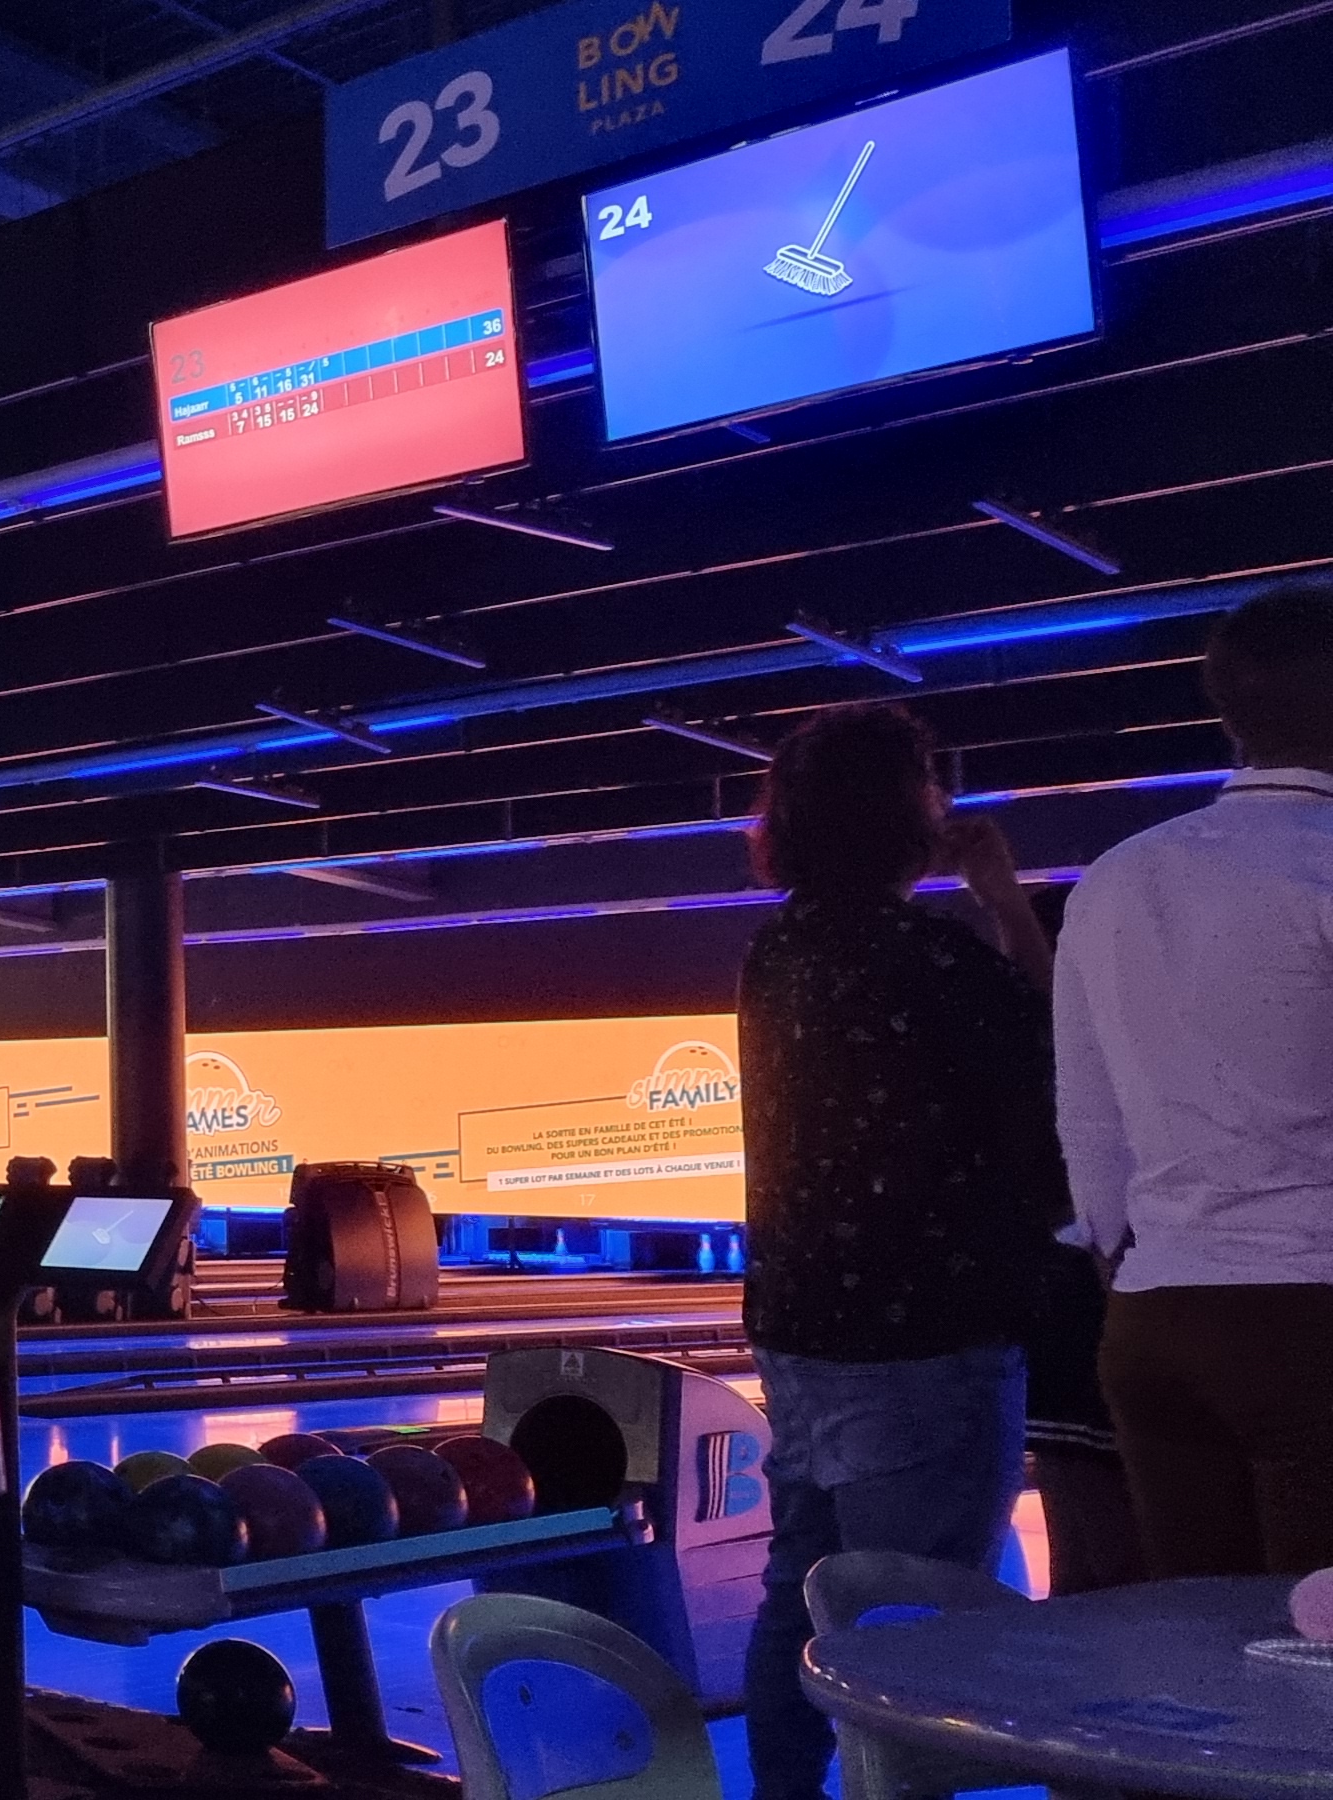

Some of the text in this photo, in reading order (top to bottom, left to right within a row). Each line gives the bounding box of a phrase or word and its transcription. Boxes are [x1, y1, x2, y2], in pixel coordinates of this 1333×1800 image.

[579, 52, 678, 111] LING
[590, 101, 665, 135] PLAZA
[379, 70, 501, 201] 23
[598, 194, 652, 241] 24
[170, 349, 206, 384] 23
[254, 384, 268, 399] 11
[277, 379, 293, 393] 16
[300, 372, 315, 387] 31
[482, 318, 502, 336] 36
[236, 420, 245, 434] 7
[256, 414, 272, 428] 15
[279, 408, 295, 423] 15
[302, 401, 319, 417] 24
[485, 349, 505, 367] 24
[649, 1081, 737, 1110] FAMILY
[186, 1105, 249, 1134] AMES
[533, 1117, 685, 1140] LA SORTIE EN FAMILLE DE CET ÉTÉ
[486, 1147, 499, 1155] DU
[547, 1141, 564, 1150] DES
[566, 1138, 599, 1147] SUPERS
[601, 1134, 646, 1144] CADEAUX
[649, 1132, 660, 1141] ET
[663, 1131, 680, 1139] DES
[683, 1125, 744, 1137] PROMOTION
[551, 1142, 670, 1160] POUR UN BON PLAN D'ÉTÉ
[190, 1161, 279, 1180] ÉTÉ BOWLING
[505, 1176, 529, 1185] SUPER
[531, 1175, 547, 1183] LOT
[549, 1174, 563, 1182] PAR
[565, 1170, 601, 1180] SEMAINE
[615, 1168, 631, 1176] DES
[634, 1166, 654, 1175] LOTS
[665, 1162, 702, 1173] CHAQUE
[704, 1160, 734, 1169] VENUE
[579, 1194, 596, 1206] 17
